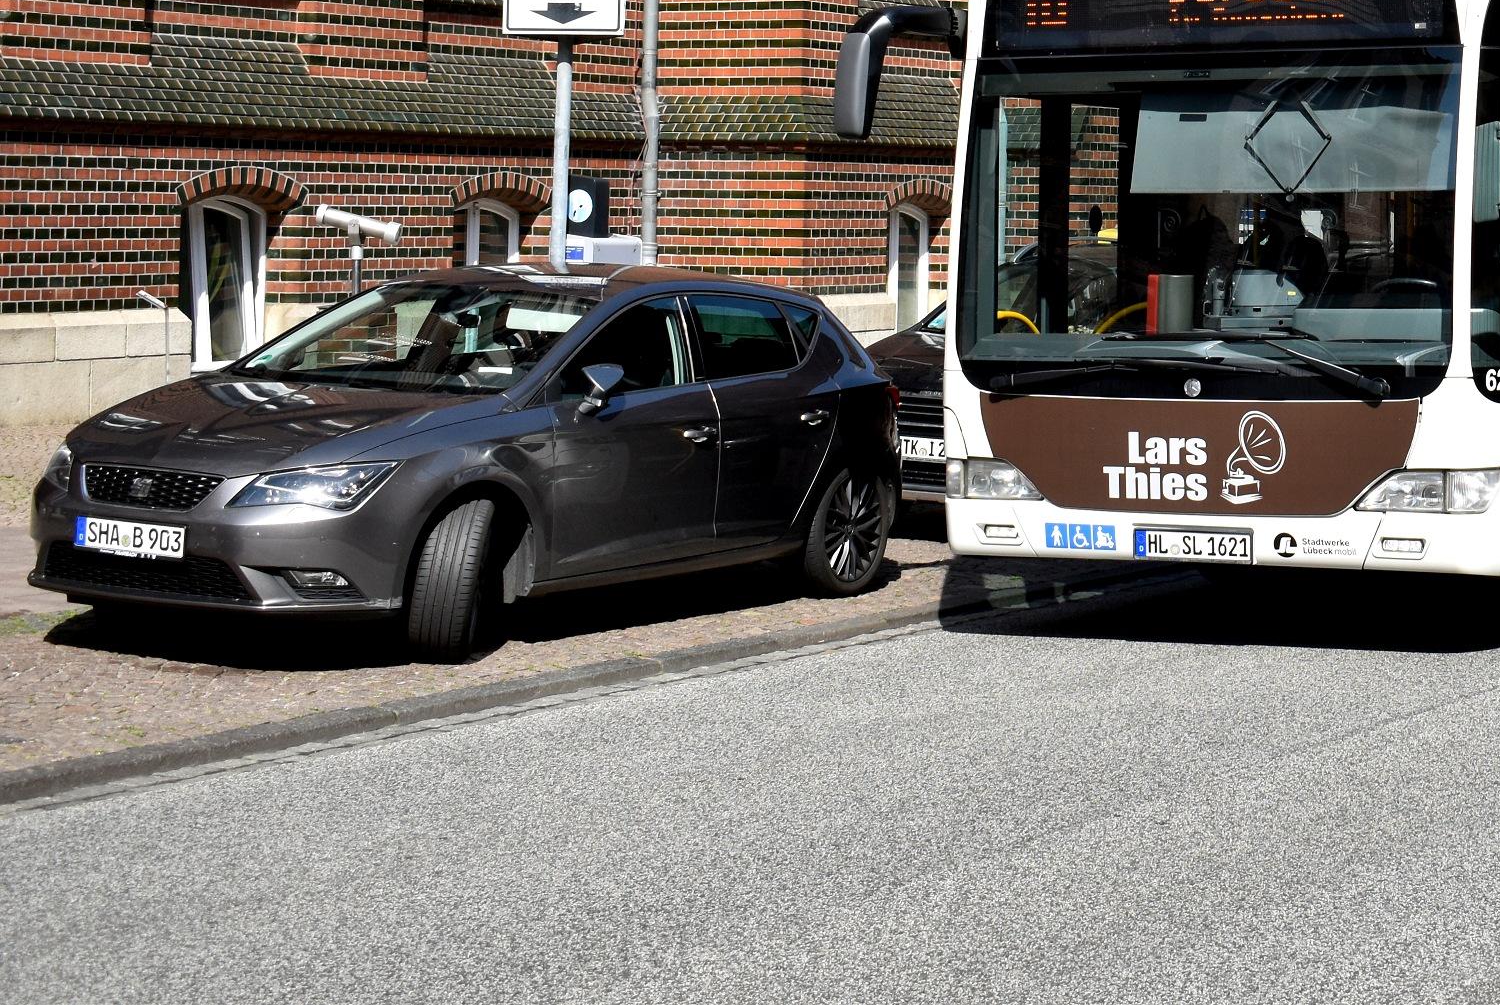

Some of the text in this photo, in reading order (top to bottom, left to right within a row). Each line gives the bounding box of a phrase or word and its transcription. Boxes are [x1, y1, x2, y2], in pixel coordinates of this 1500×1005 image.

[903, 439, 918, 456] TK
[1127, 431, 1208, 466] Lars
[1103, 466, 1208, 502] Thies
[87, 521, 120, 546] SHA
[133, 526, 143, 548] B
[148, 528, 181, 553] 903
[1148, 533, 1168, 554] HL
[1182, 535, 1202, 555] SL
[1207, 536, 1249, 558] 1621
[1302, 537, 1350, 547] Stadtwerke
[1302, 546, 1357, 556] Lübeck mobil
